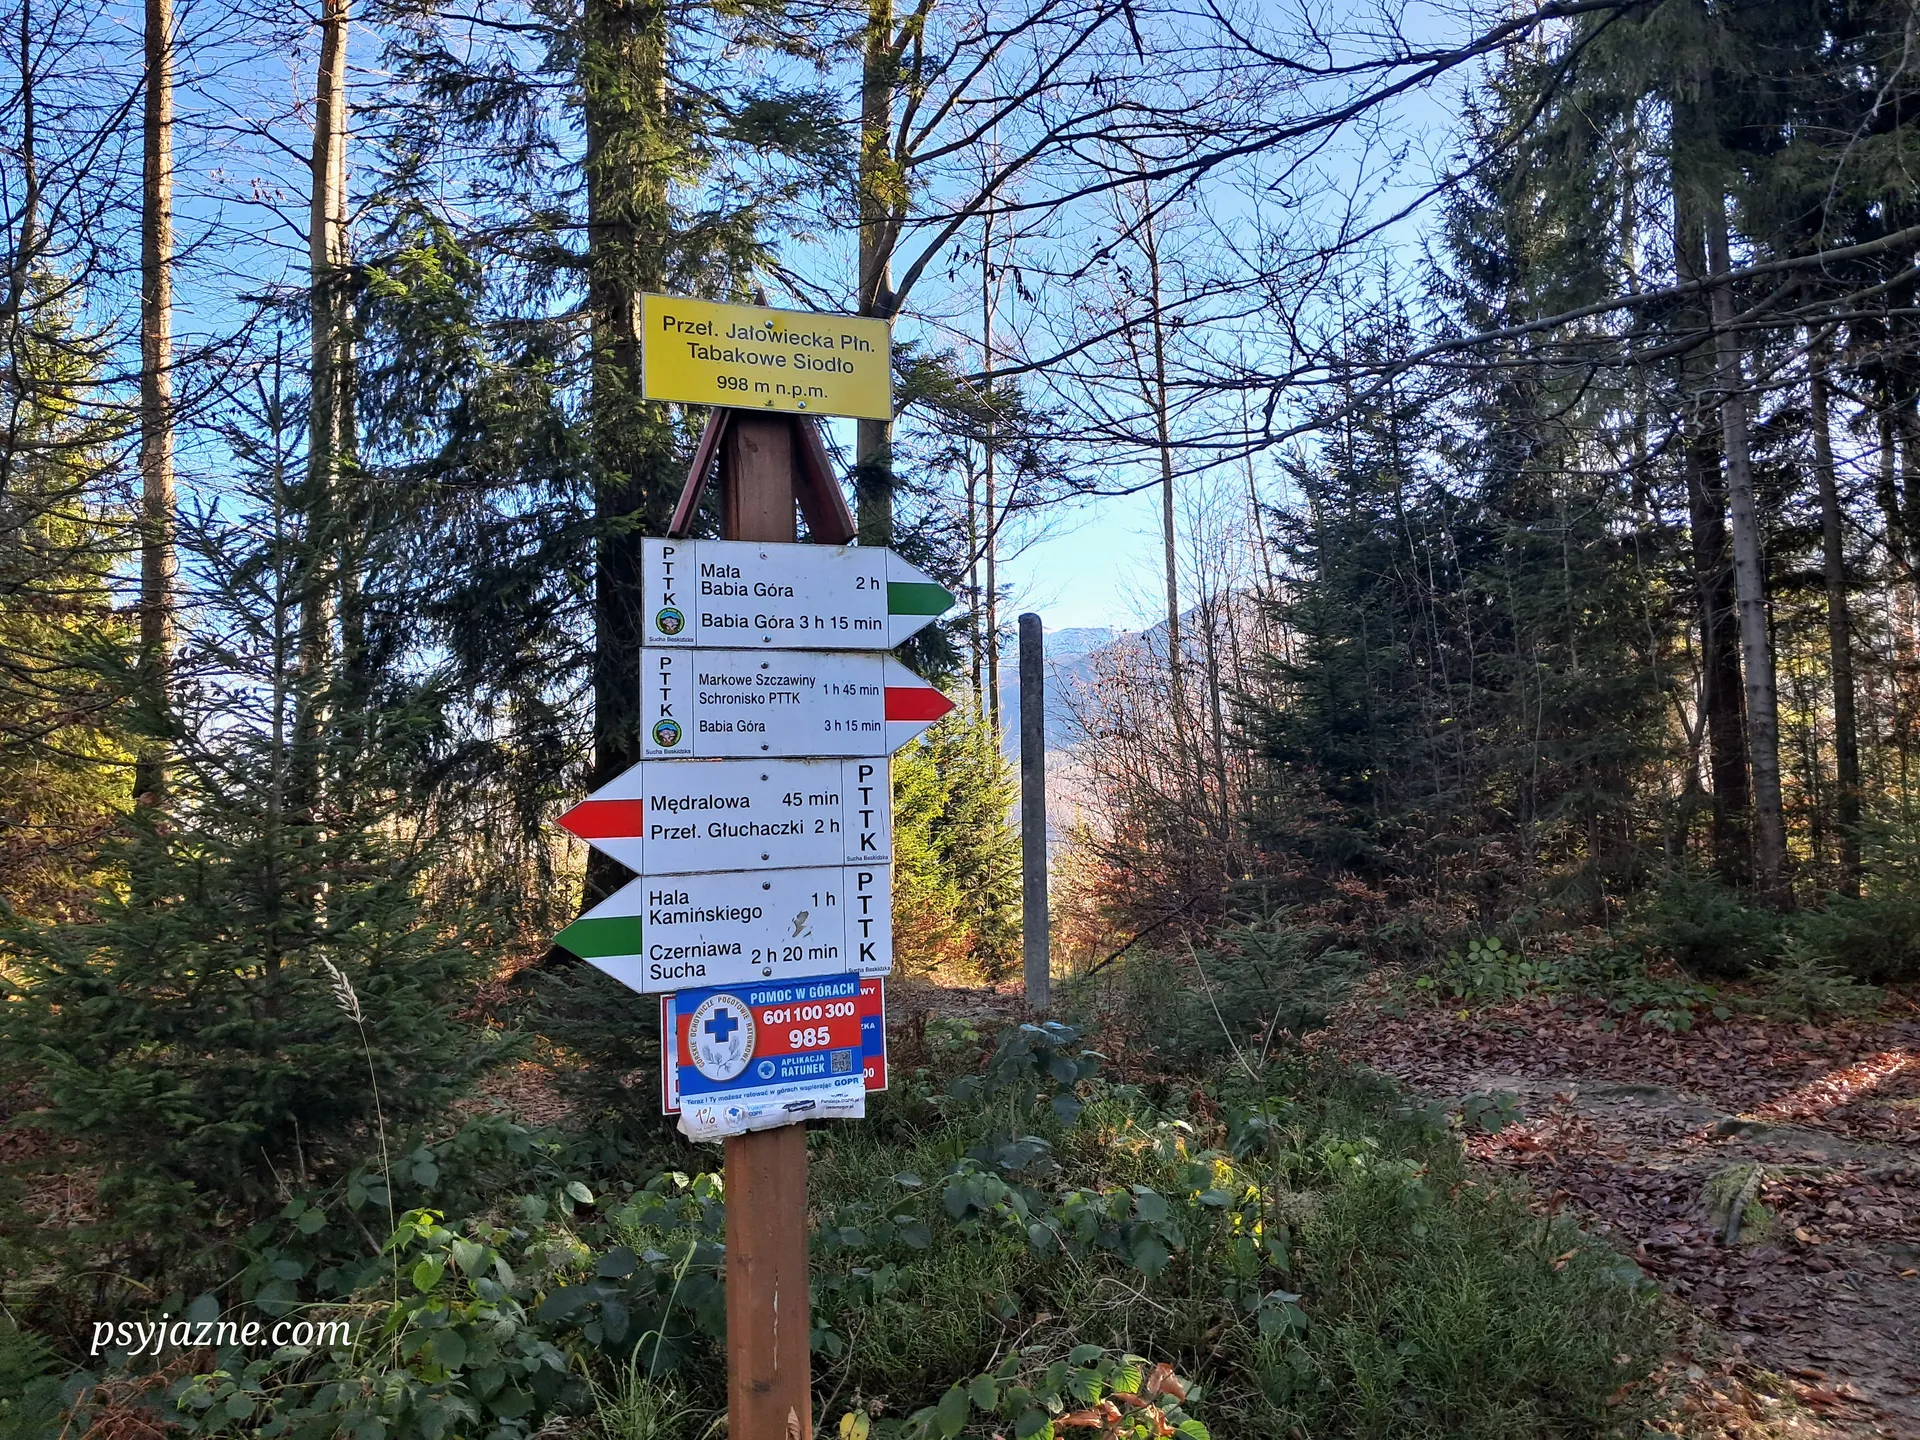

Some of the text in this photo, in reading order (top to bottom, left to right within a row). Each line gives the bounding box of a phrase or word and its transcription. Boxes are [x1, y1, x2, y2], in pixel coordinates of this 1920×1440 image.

[663, 315, 875, 353] Przeł. Jałowiecka Płn.
[687, 342, 854, 374] Tabakowe Siodło
[716, 376, 828, 398] 998 m n.p.m.
[663, 546, 676, 606] PTTK
[701, 563, 741, 579] Mała
[701, 581, 794, 598] Babia Góra
[855, 576, 880, 590] 2 h
[701, 613, 749, 628] Babia
[754, 614, 795, 629] Góra
[799, 616, 809, 629] 3
[815, 615, 824, 629] h
[830, 616, 848, 630] 15
[854, 616, 882, 630] min
[659, 657, 673, 717] PTTK
[699, 673, 816, 688] Markowe Szczawiny
[823, 683, 879, 696] 1 h 45 min
[699, 692, 801, 705] Schronisko PTTK
[699, 719, 881, 733] Babia Góra 3 h 15 min
[651, 791, 839, 814] Mędralowa 45 min
[858, 764, 877, 851] PTTK
[651, 819, 840, 840] Przeł. Głuchaczki 2 h
[649, 889, 689, 906] Hala
[811, 891, 835, 907] 1 h
[649, 905, 763, 925] Kamińskiego
[857, 872, 876, 962] PTTK
[649, 941, 742, 961] Czerniawa
[751, 944, 838, 964] 2 h 20 min
[649, 963, 706, 980] Sucha
[750, 992, 792, 1005] POMOC
[796, 987, 806, 1000] W
[809, 983, 854, 998] GÓRACH
[825, 1001, 855, 1018] 300
[690, 1000, 714, 1038] OCHOTNICZE
[718, 996, 750, 1020] POGOTOWIE
[740, 1022, 753, 1063] RATUNKOWE
[789, 1026, 831, 1049] 985
[781, 1054, 825, 1066] APLIKACJA
[781, 1062, 825, 1078] RATUNEK
[718, 1094, 742, 1102] możesz
[777, 1086, 798, 1096] górach
[834, 1077, 859, 1087] GOPR
[695, 1107, 716, 1125] 1%
